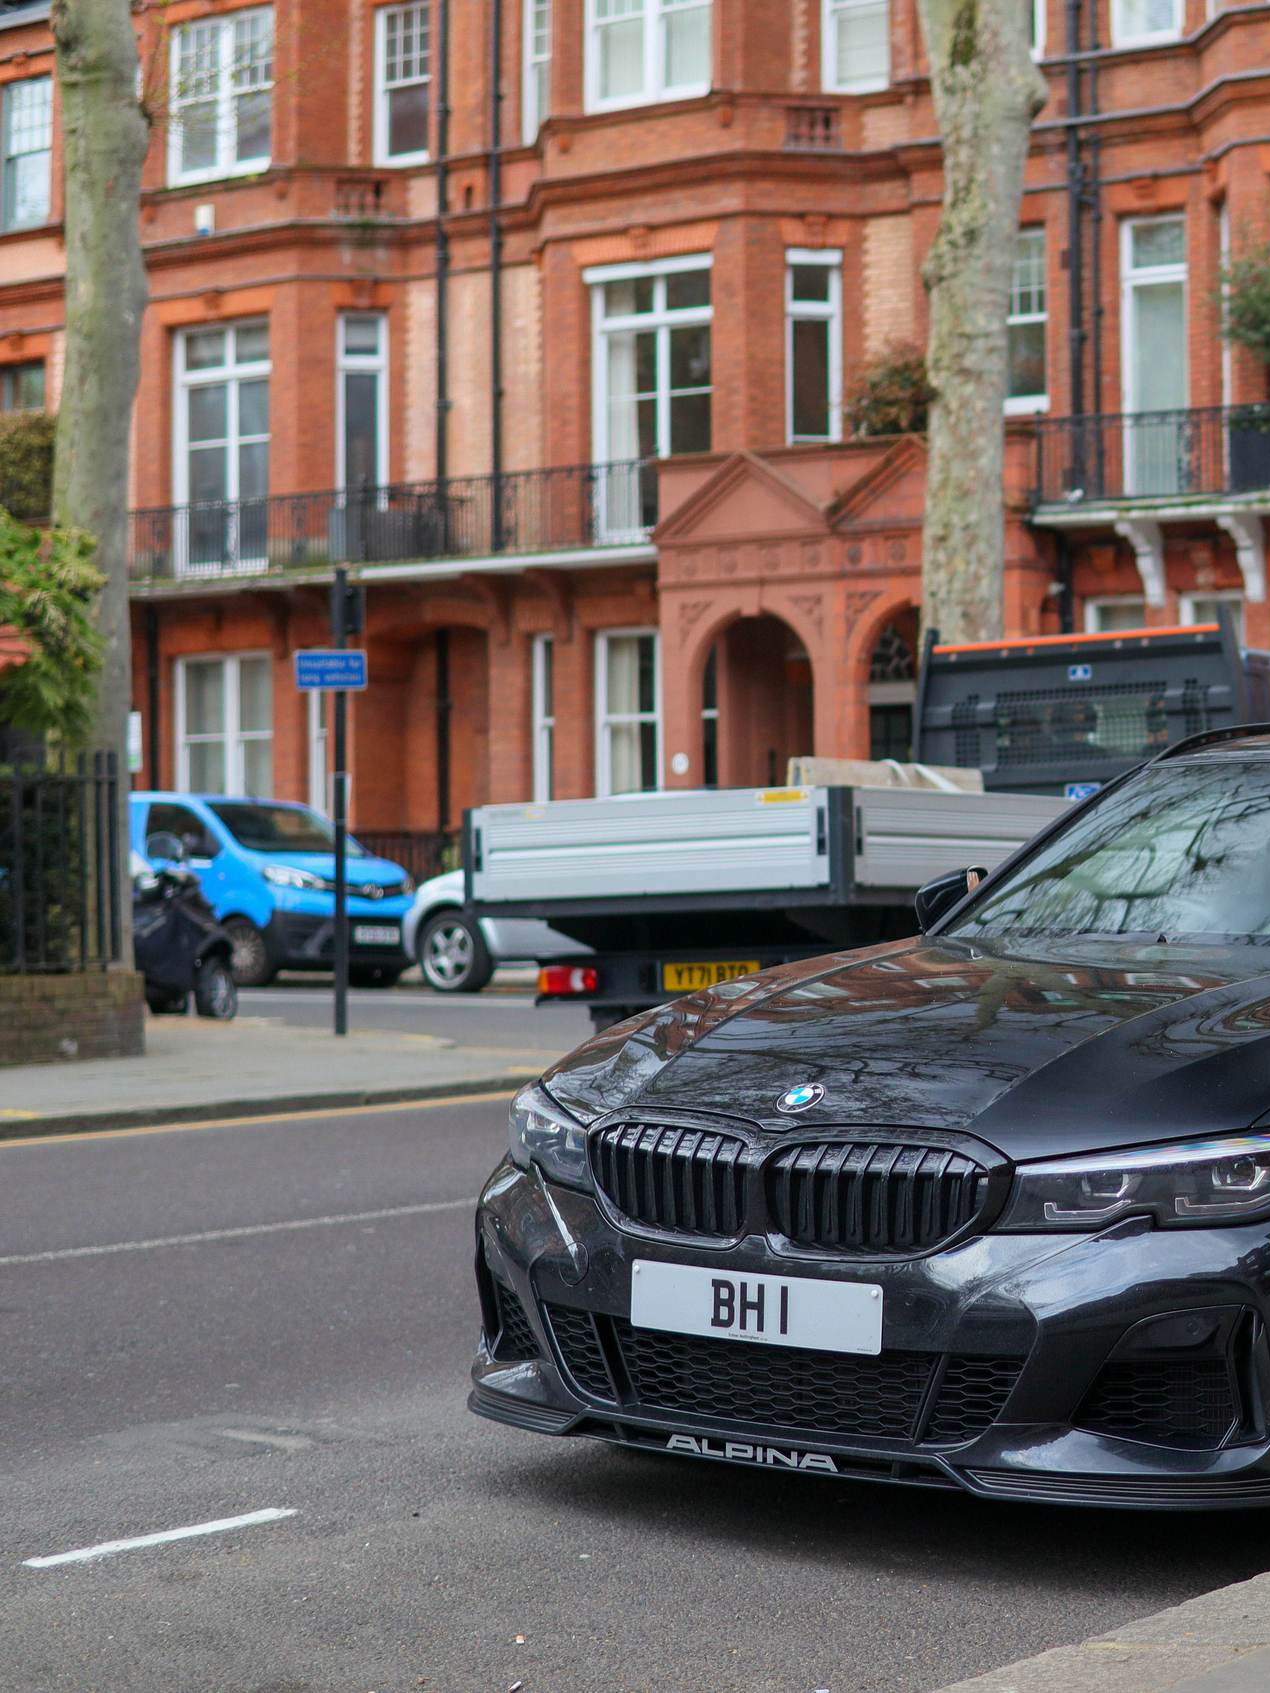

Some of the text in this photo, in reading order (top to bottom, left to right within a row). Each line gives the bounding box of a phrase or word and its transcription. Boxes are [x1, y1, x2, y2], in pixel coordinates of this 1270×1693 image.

[675, 966, 712, 985] YT71
[711, 1279, 765, 1332] BH
[666, 1434, 838, 1473] ALPINA
